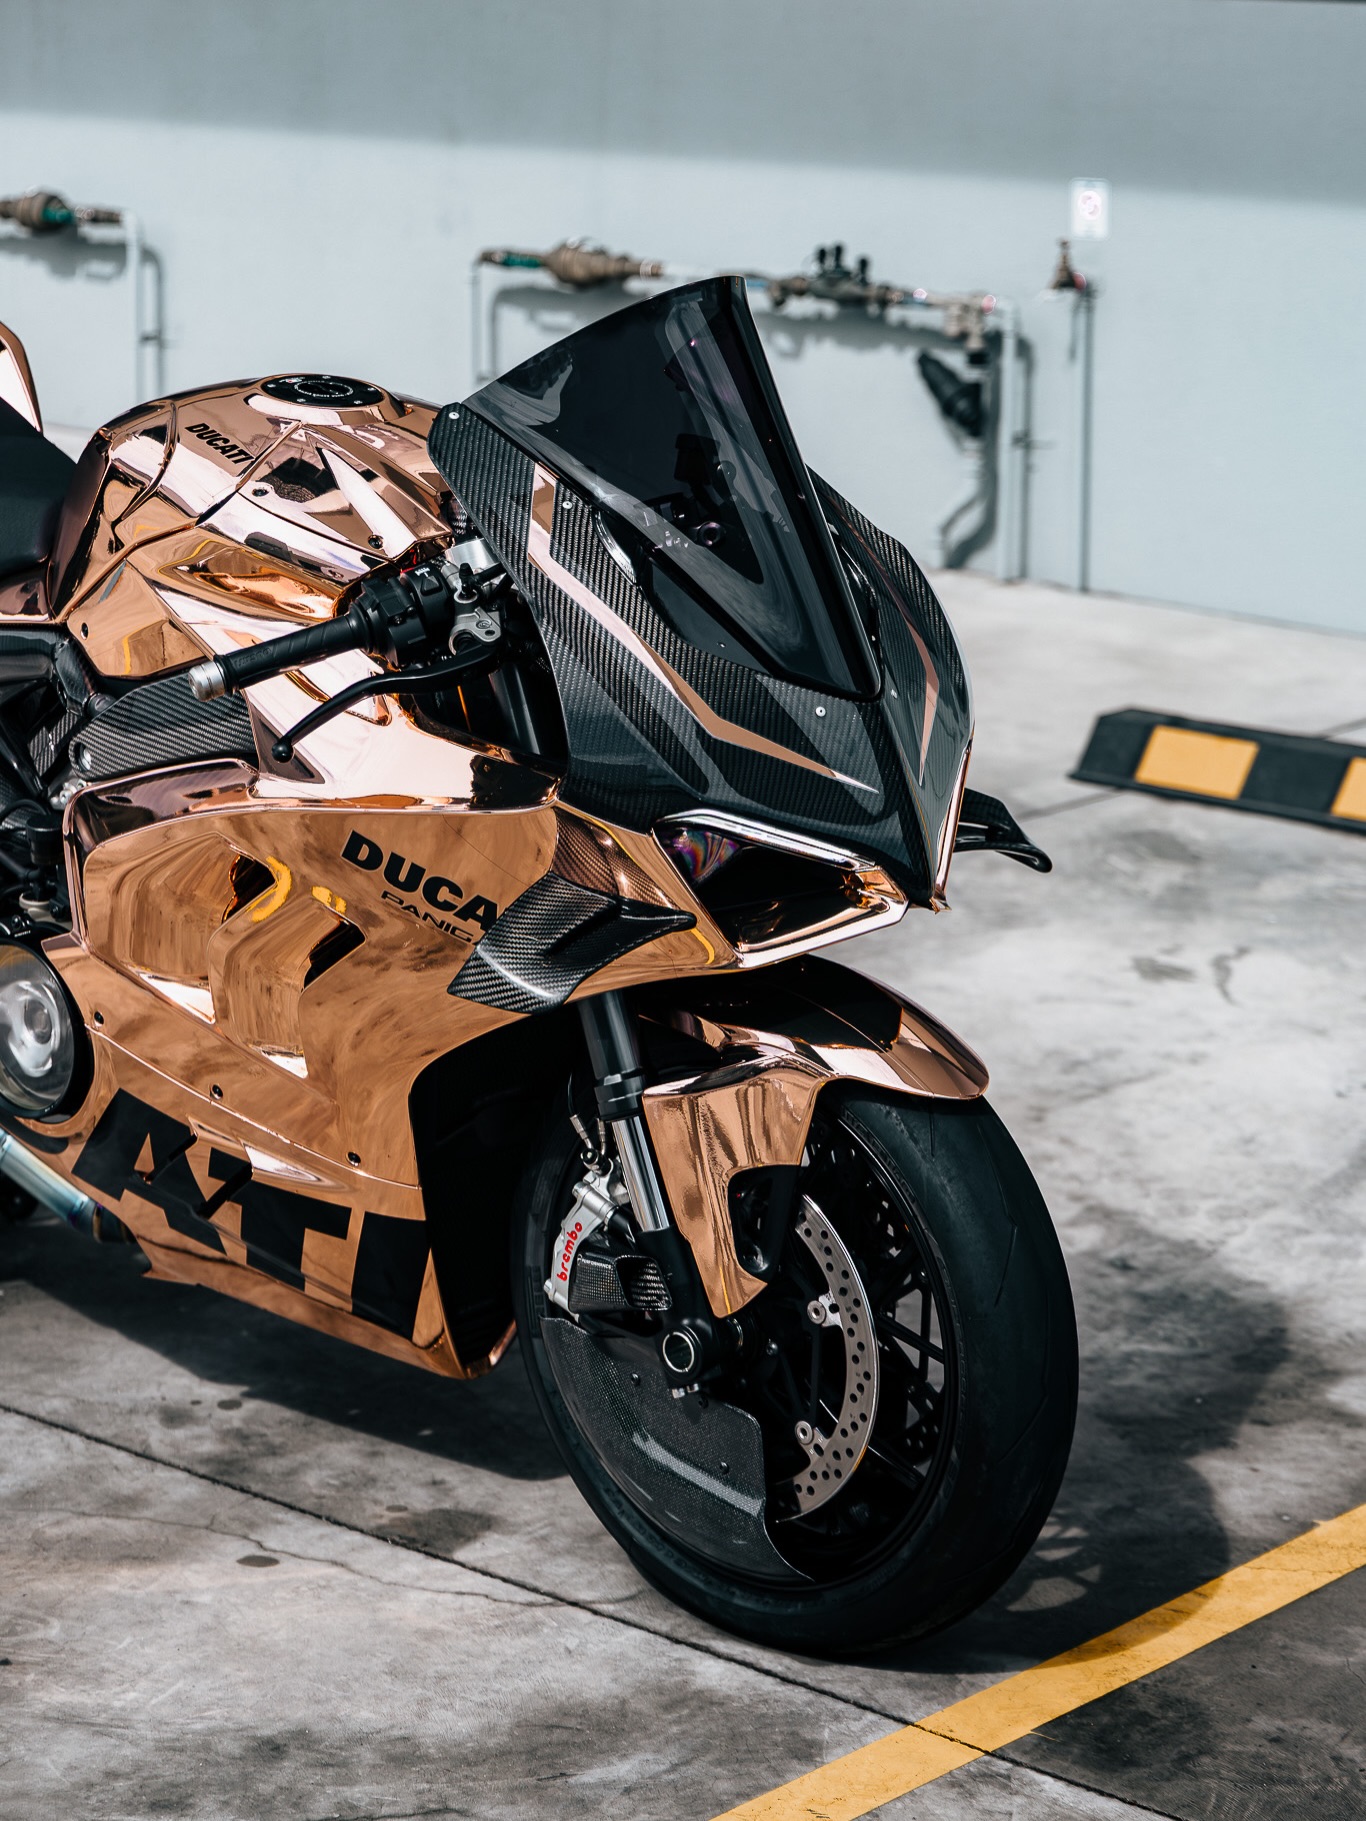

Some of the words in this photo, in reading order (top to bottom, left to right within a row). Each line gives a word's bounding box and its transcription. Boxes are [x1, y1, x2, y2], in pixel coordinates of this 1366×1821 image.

[184, 422, 255, 465] DUCATI
[341, 830, 499, 932] DUCA
[0, 1088, 428, 1340] ATI
[556, 1221, 583, 1281] brembo
